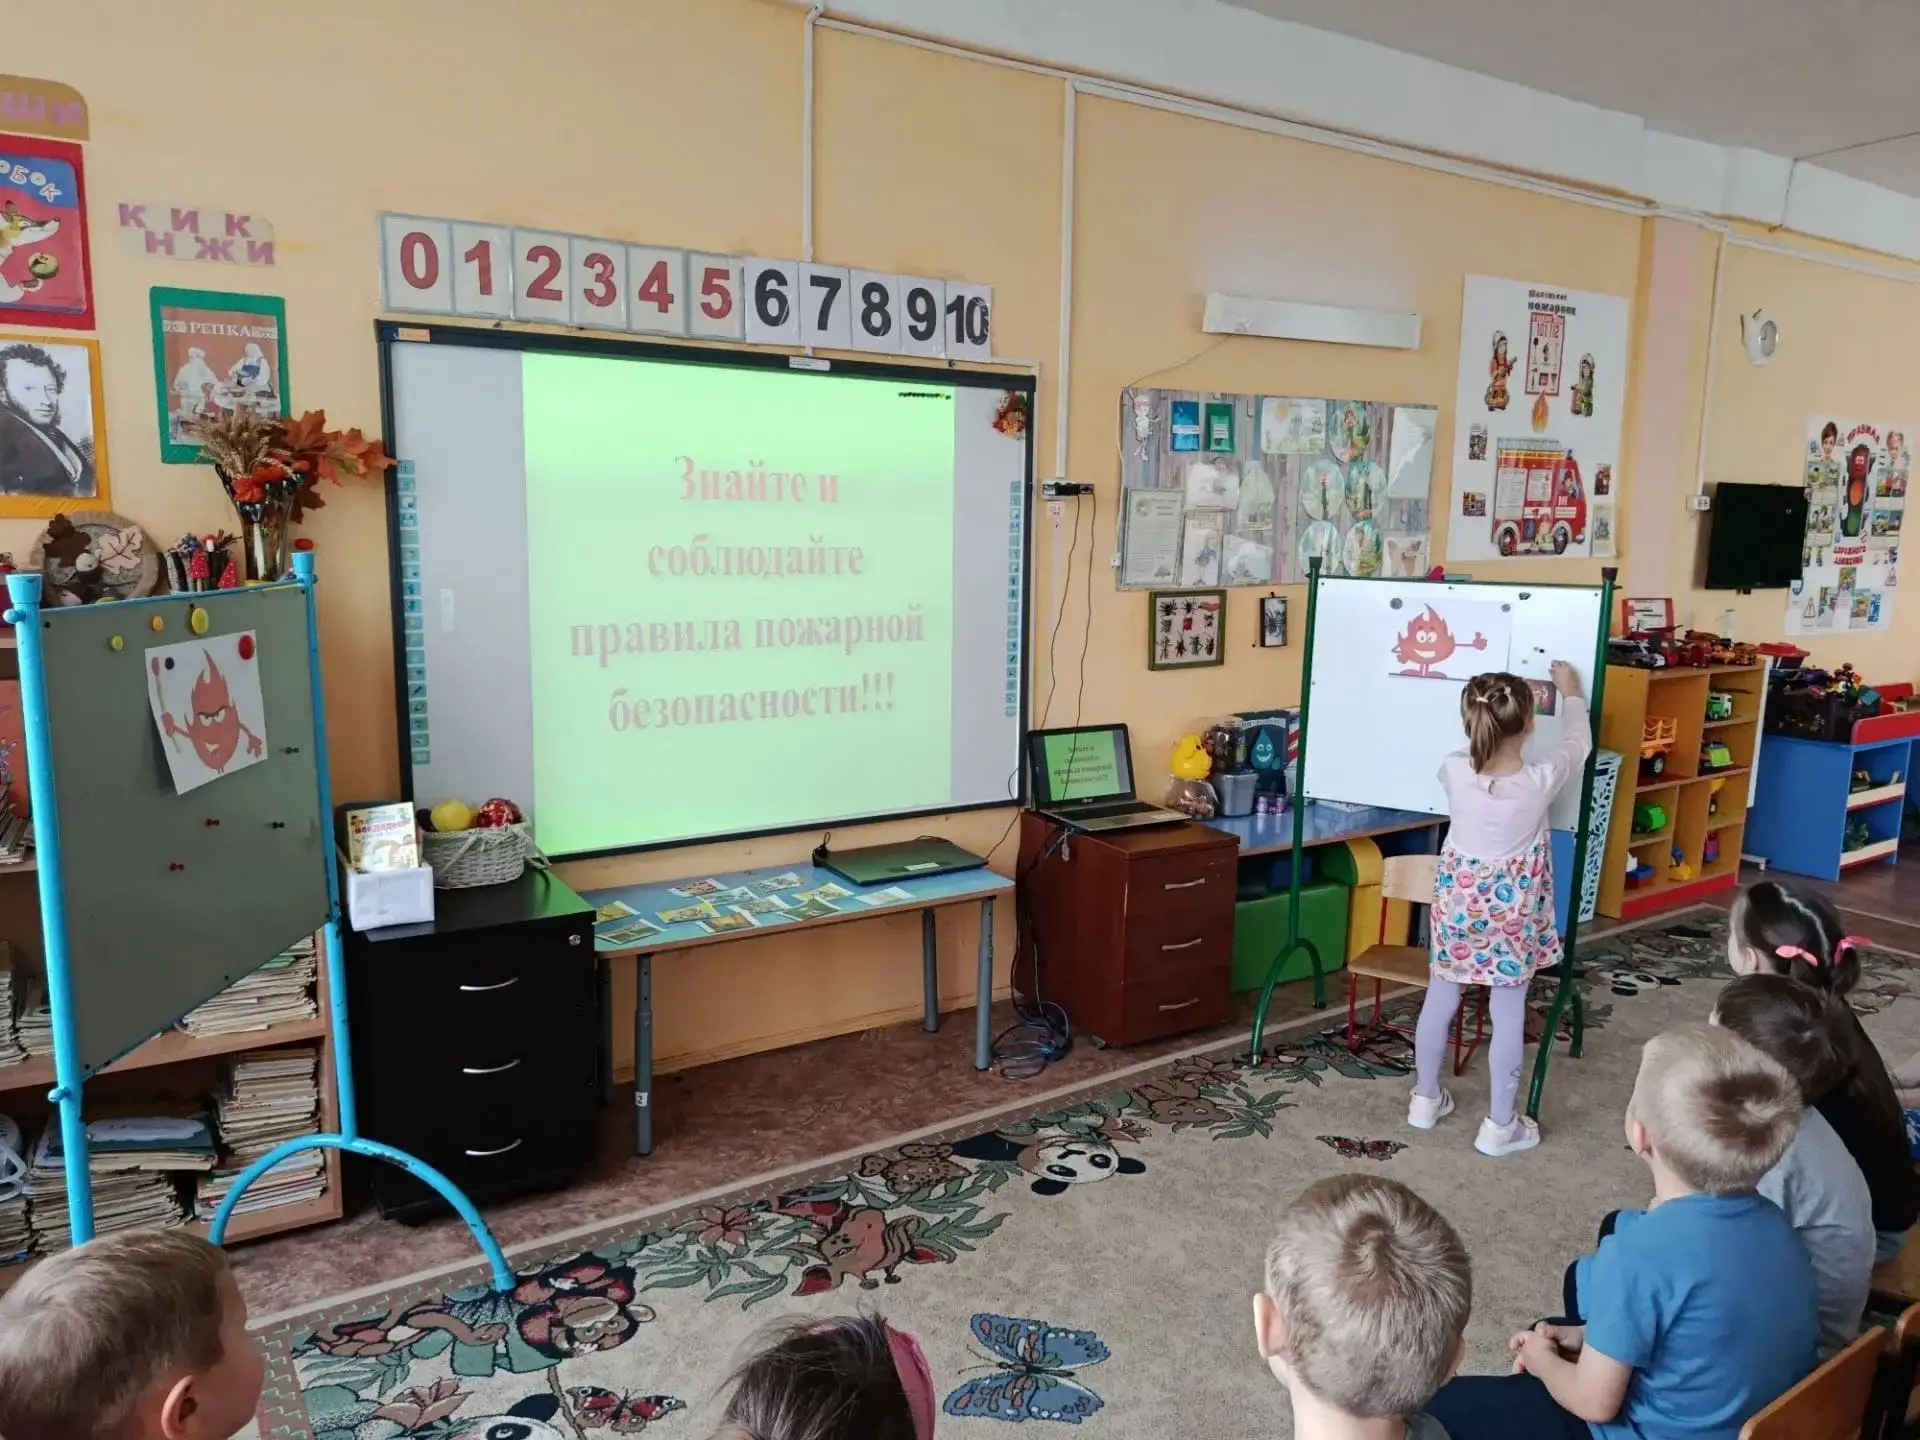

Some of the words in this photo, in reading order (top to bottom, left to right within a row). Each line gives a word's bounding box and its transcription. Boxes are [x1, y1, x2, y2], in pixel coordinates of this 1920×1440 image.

[400, 232, 439, 289] 0
[464, 240, 494, 296] 1
[525, 246, 563, 301] 2
[583, 254, 617, 306] 3
[638, 261, 674, 313] 4
[700, 268, 733, 319] 5
[754, 269, 790, 327] 6
[810, 277, 842, 331] 7
[861, 282, 892, 337] 8
[907, 288, 937, 341] 9
[947, 294, 990, 346] 10
[190, 321, 251, 337] РЕПКА
[675, 455, 806, 503] Знайте
[818, 473, 840, 504] и
[647, 534, 864, 579] соблюдайте
[569, 618, 742, 668] правила
[755, 603, 925, 655] пожарной
[609, 672, 894, 732] безопасности!!!
